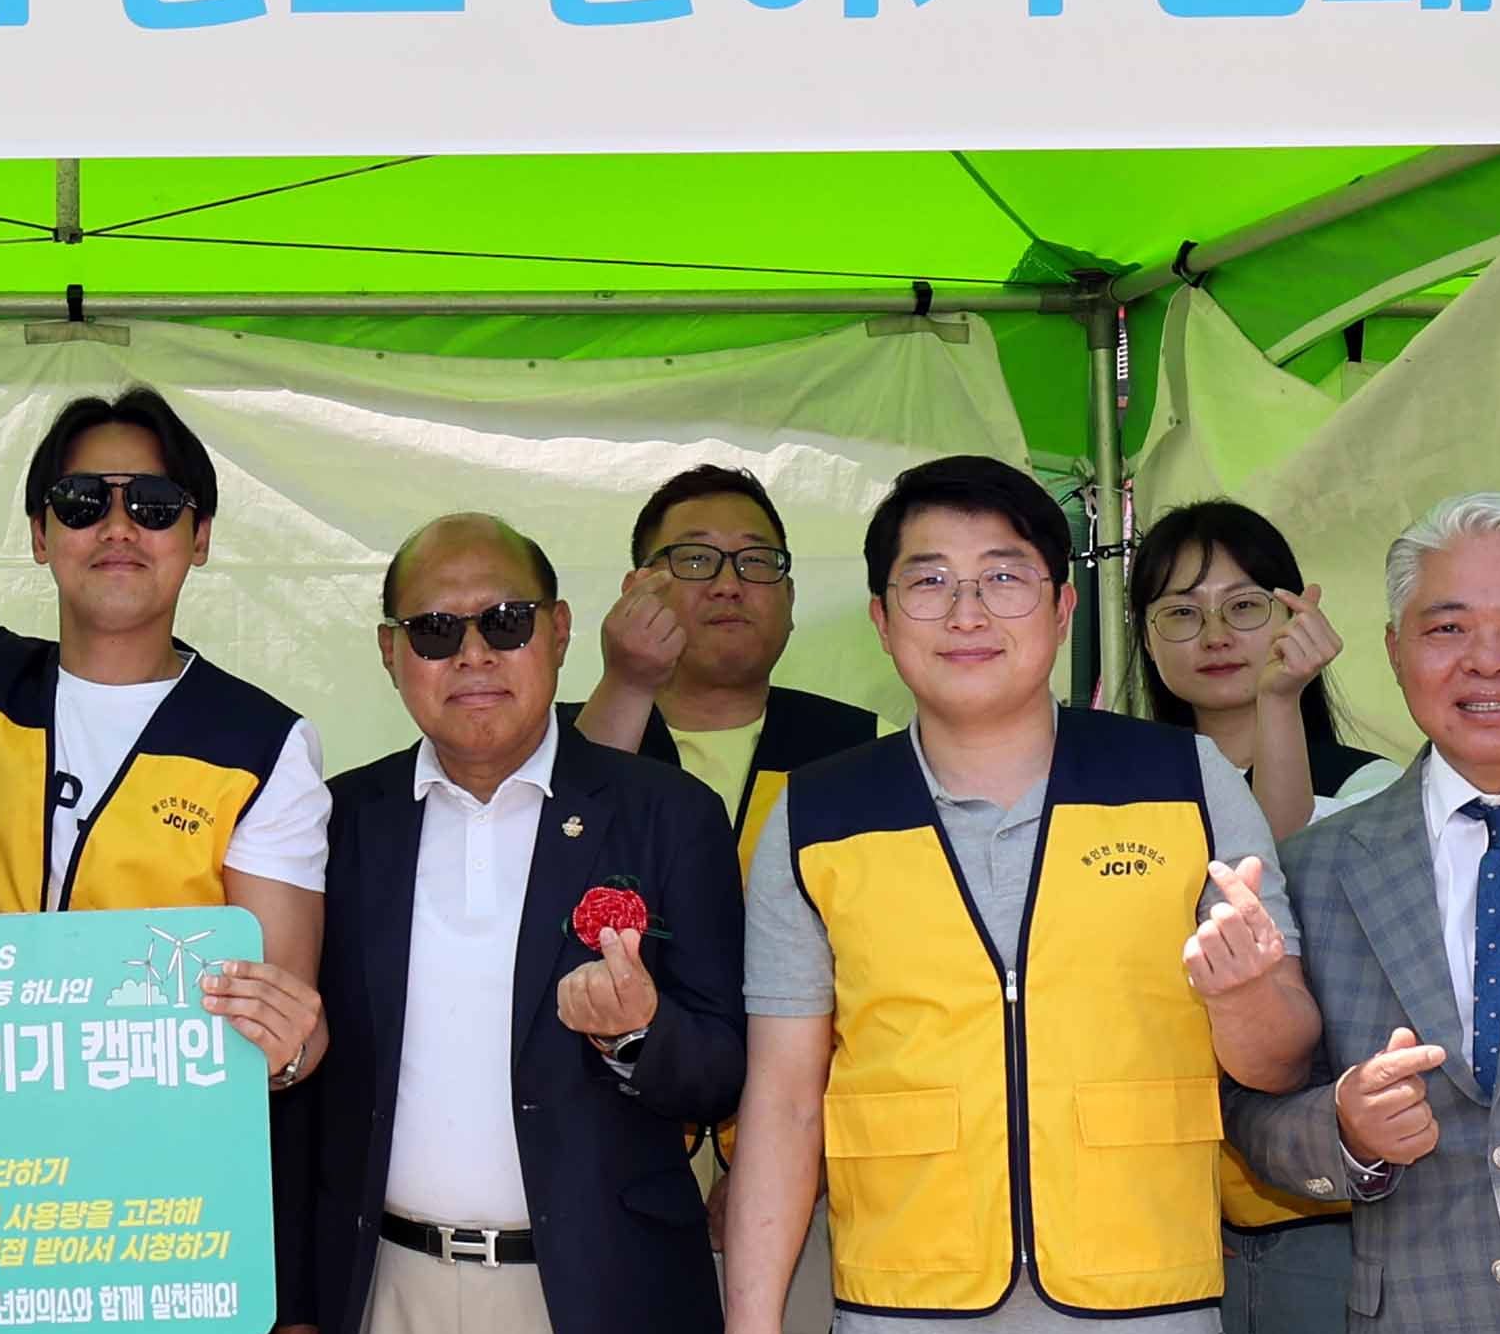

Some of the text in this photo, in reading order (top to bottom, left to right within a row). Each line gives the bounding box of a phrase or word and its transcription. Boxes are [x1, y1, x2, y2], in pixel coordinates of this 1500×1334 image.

[162, 813, 188, 832] JCI
[1099, 861, 1132, 876] JCI
[19, 978, 92, 1006] 하나인
[80, 1016, 227, 1092] 캠페인
[2, 1200, 115, 1234] 사용량을
[117, 1197, 203, 1229] 고려해
[32, 1235, 117, 1267] 받아서
[120, 1231, 231, 1264] 시청하기
[98, 1286, 145, 1324] 함께
[149, 1282, 239, 1322] 실천해요!
